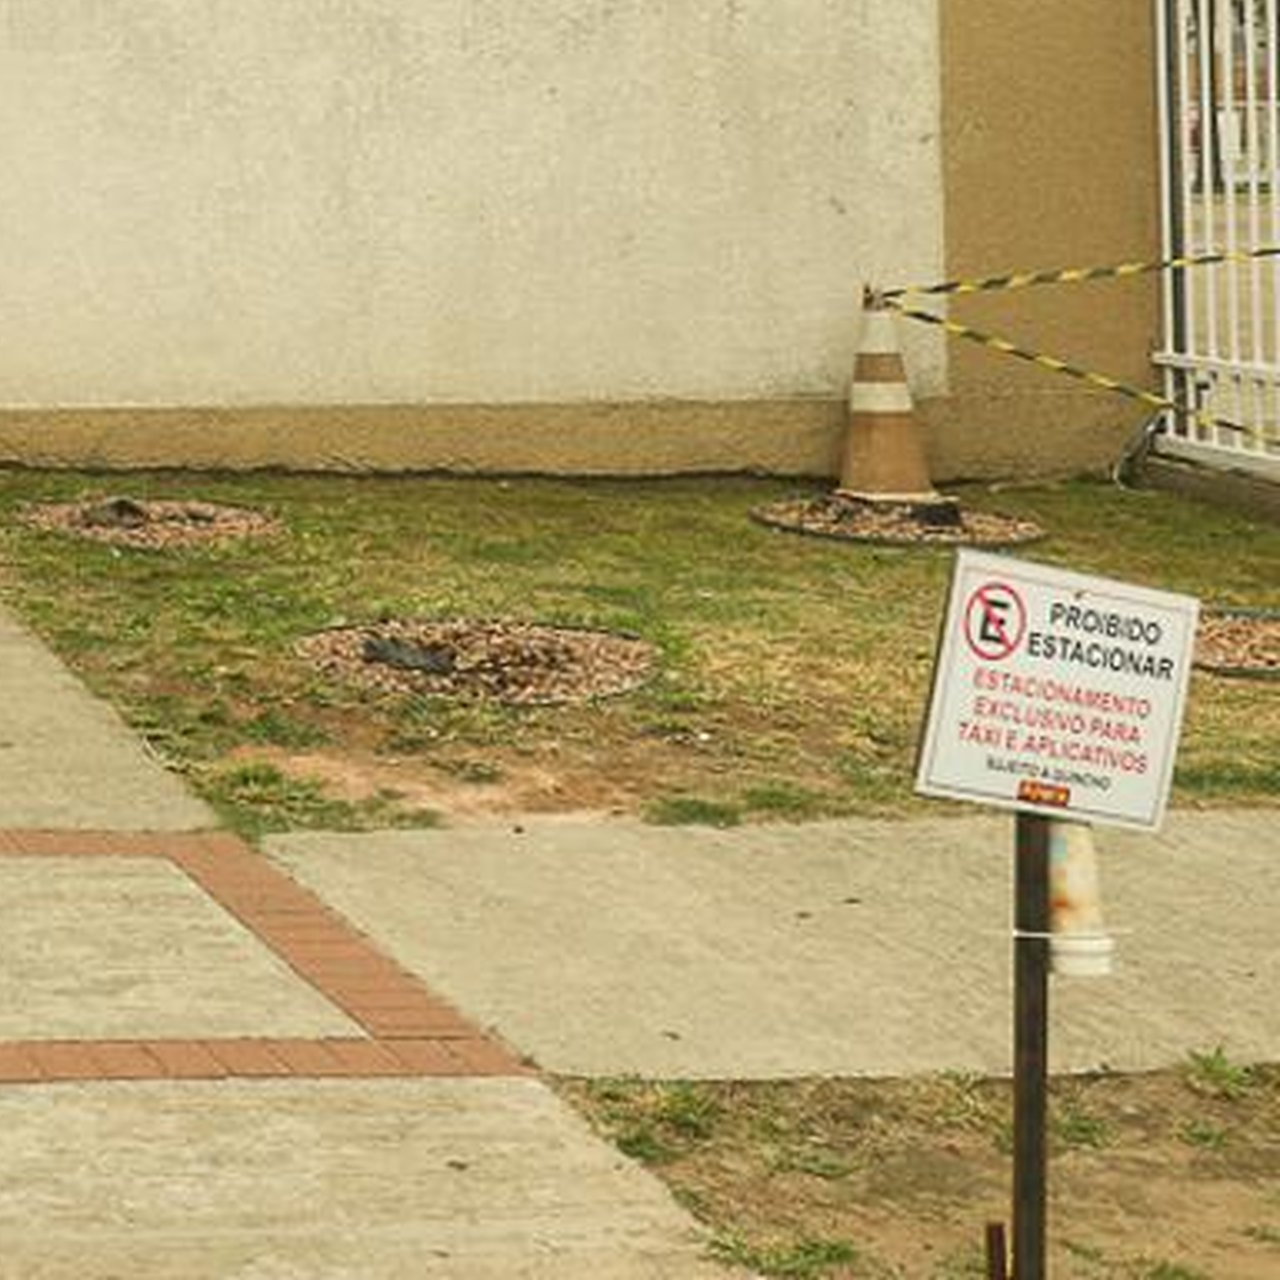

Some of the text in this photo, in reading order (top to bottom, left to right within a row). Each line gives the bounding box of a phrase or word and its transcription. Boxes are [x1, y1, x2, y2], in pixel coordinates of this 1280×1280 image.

[1050, 602, 1163, 646] PROIBIDO
[1027, 632, 1174, 680] ESTACIONAR
[973, 666, 1152, 719] ESTACIONAMENTO
[973, 696, 1141, 742] EXCLUSIVO PARA
[1005, 728, 1018, 750] E
[1023, 735, 1148, 774] APLICATIVOS
